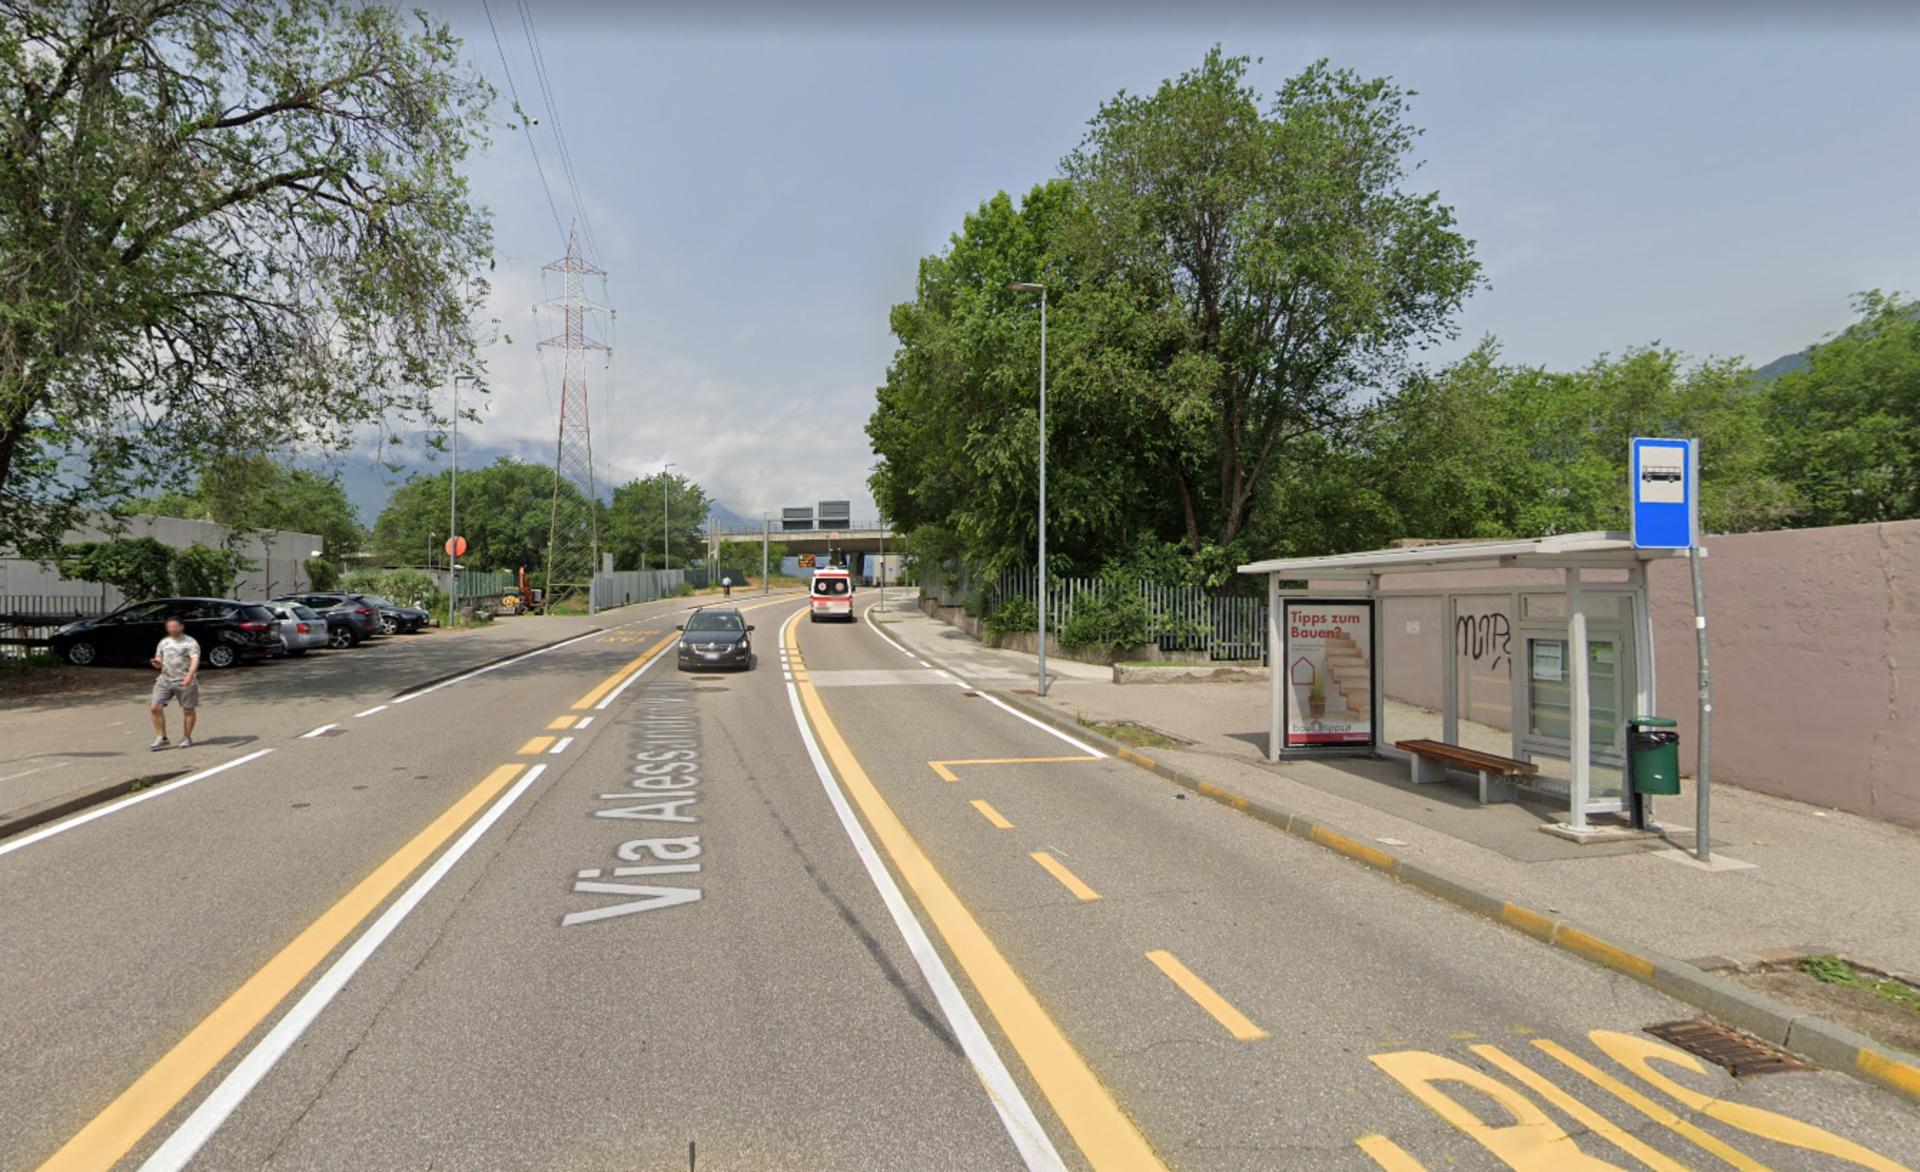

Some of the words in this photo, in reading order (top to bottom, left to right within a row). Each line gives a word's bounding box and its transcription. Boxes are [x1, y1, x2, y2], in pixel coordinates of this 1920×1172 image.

[1291, 611, 1327, 626] Tipps
[1331, 614, 1360, 624] zum
[1291, 626, 1341, 638] Bauen?
